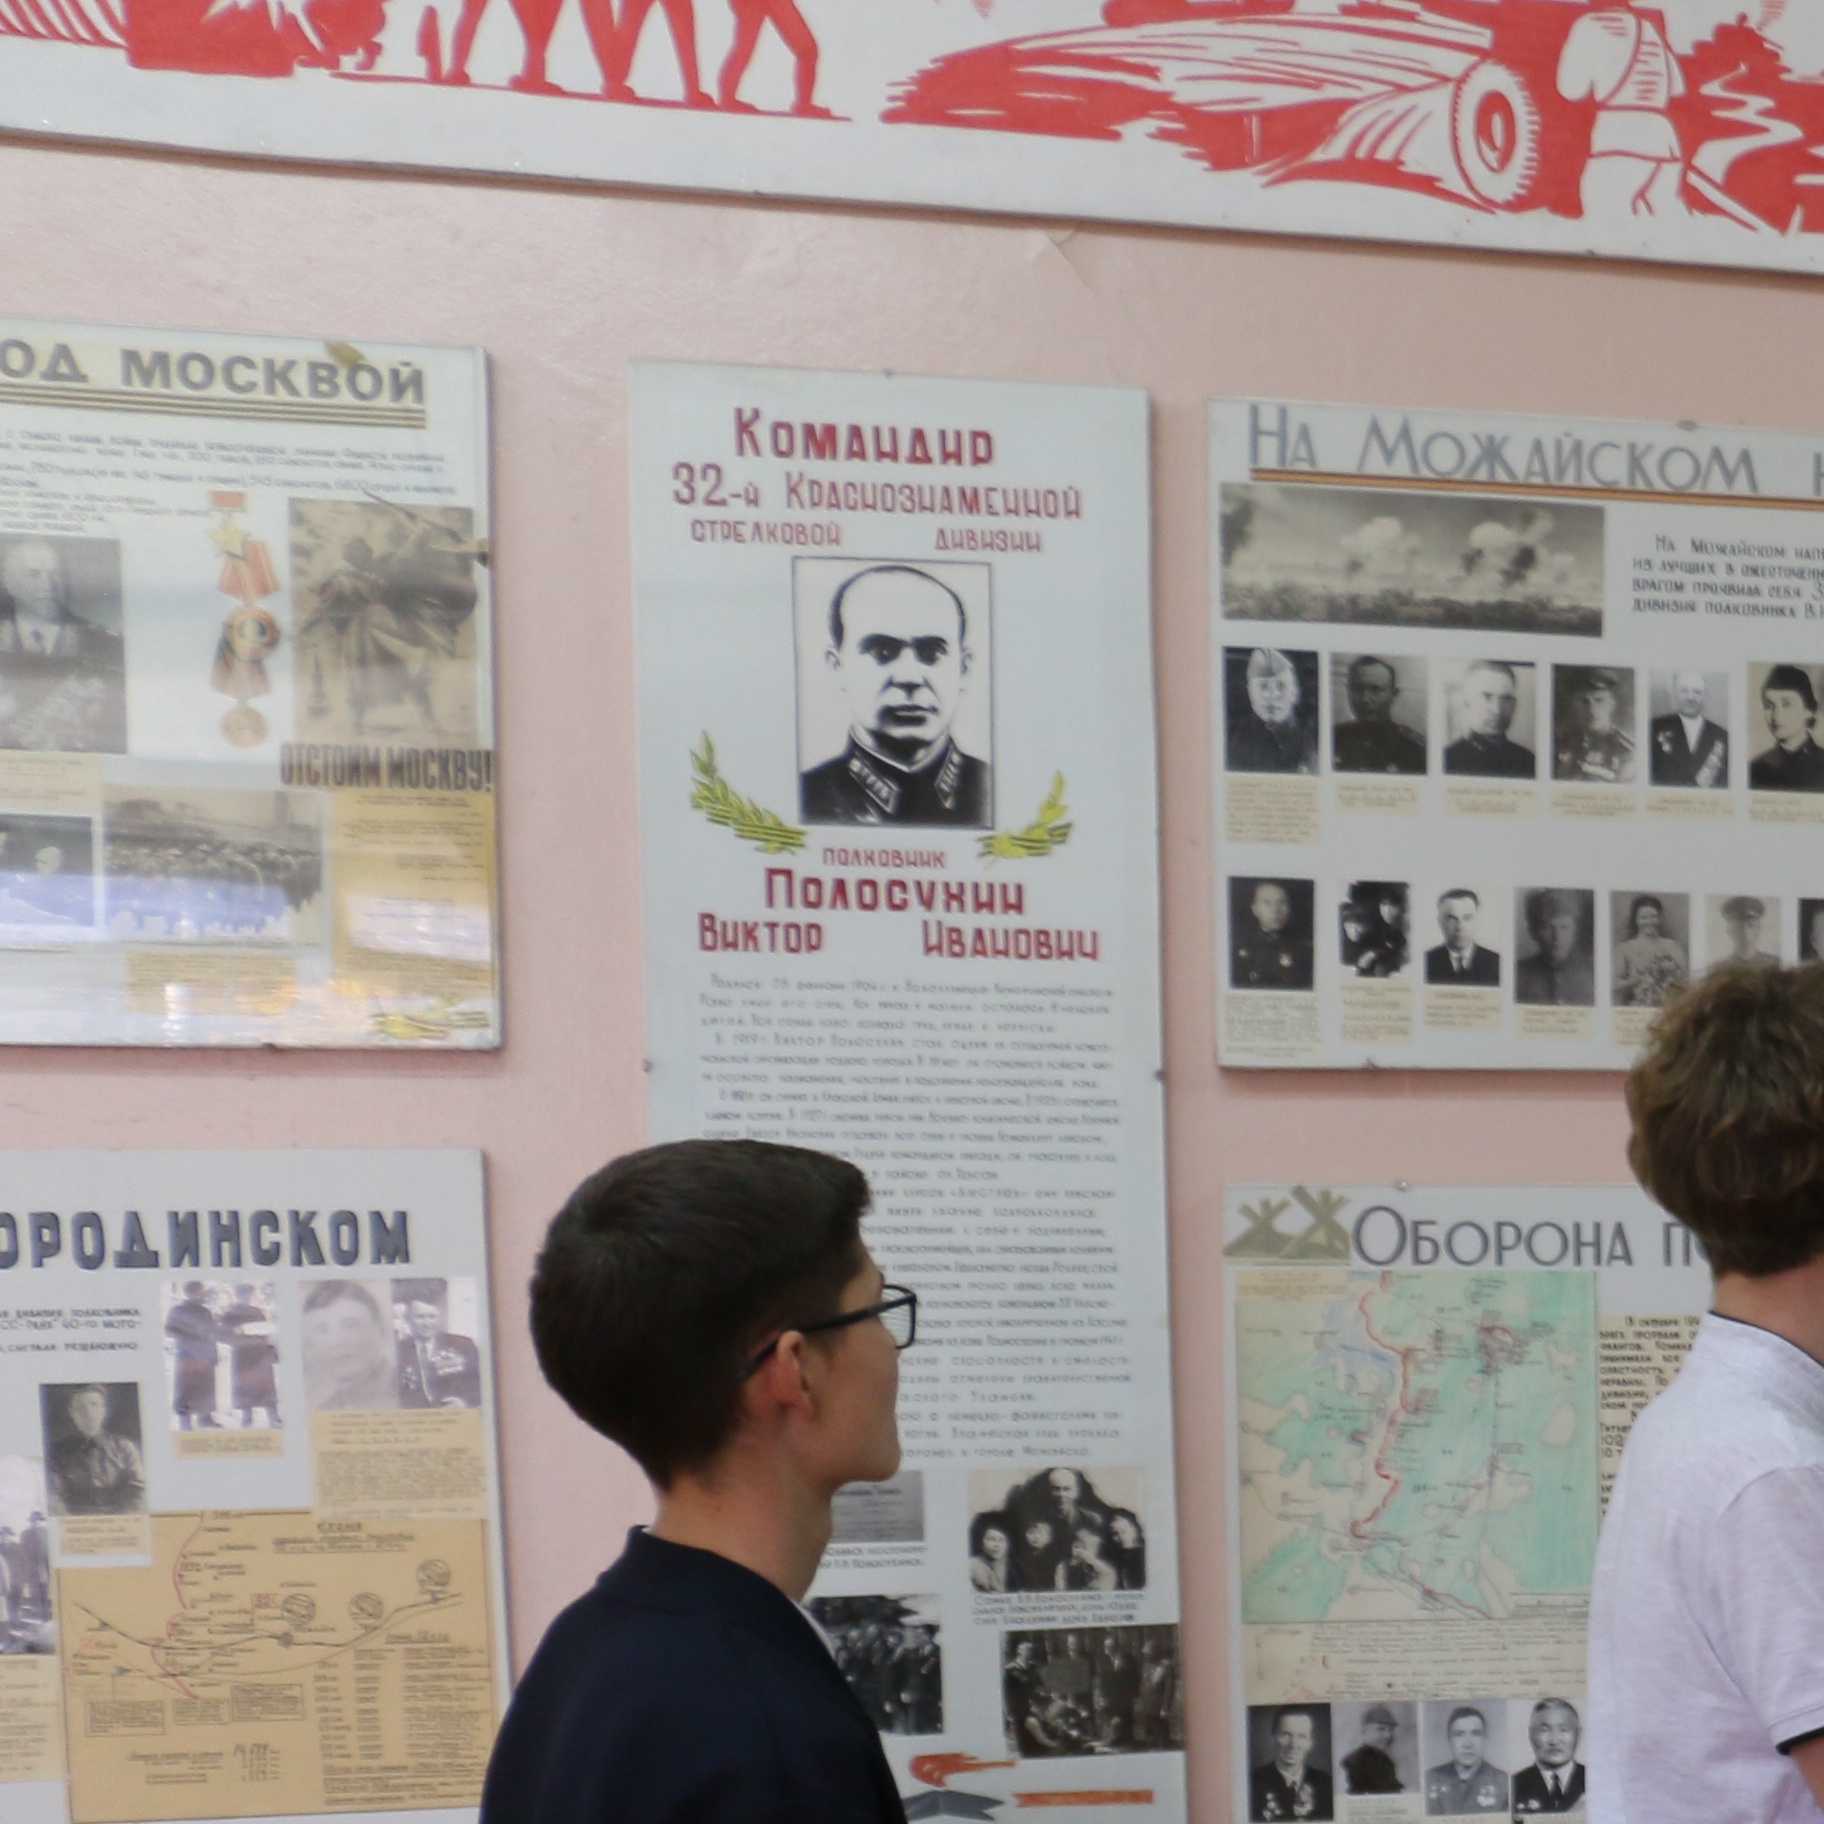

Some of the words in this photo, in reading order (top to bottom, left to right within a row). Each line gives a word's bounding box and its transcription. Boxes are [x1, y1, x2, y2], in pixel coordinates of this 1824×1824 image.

[120, 348, 425, 404] МОСКВОЙ
[734, 406, 996, 467] КОМАНДИР
[1358, 414, 1760, 494] МОЖАЙСКОМ
[785, 471, 1082, 519] КРАСНОЗНАМЕННОЙ
[691, 519, 841, 546] СТРЕЛКОВОЙ
[934, 527, 1042, 554] ДИВИЗИИ
[281, 744, 380, 787] ОТСТОИМ
[388, 747, 492, 792] МОСКВУ!
[822, 846, 945, 869] ПОЛКОВНИК
[764, 867, 1024, 916] ПОЛОСУХИН
[698, 912, 823, 954] ВИКТОР
[921, 920, 1099, 961] ИВАНОВИЧ
[1352, 1205, 1634, 1269] ОБОРОНА
